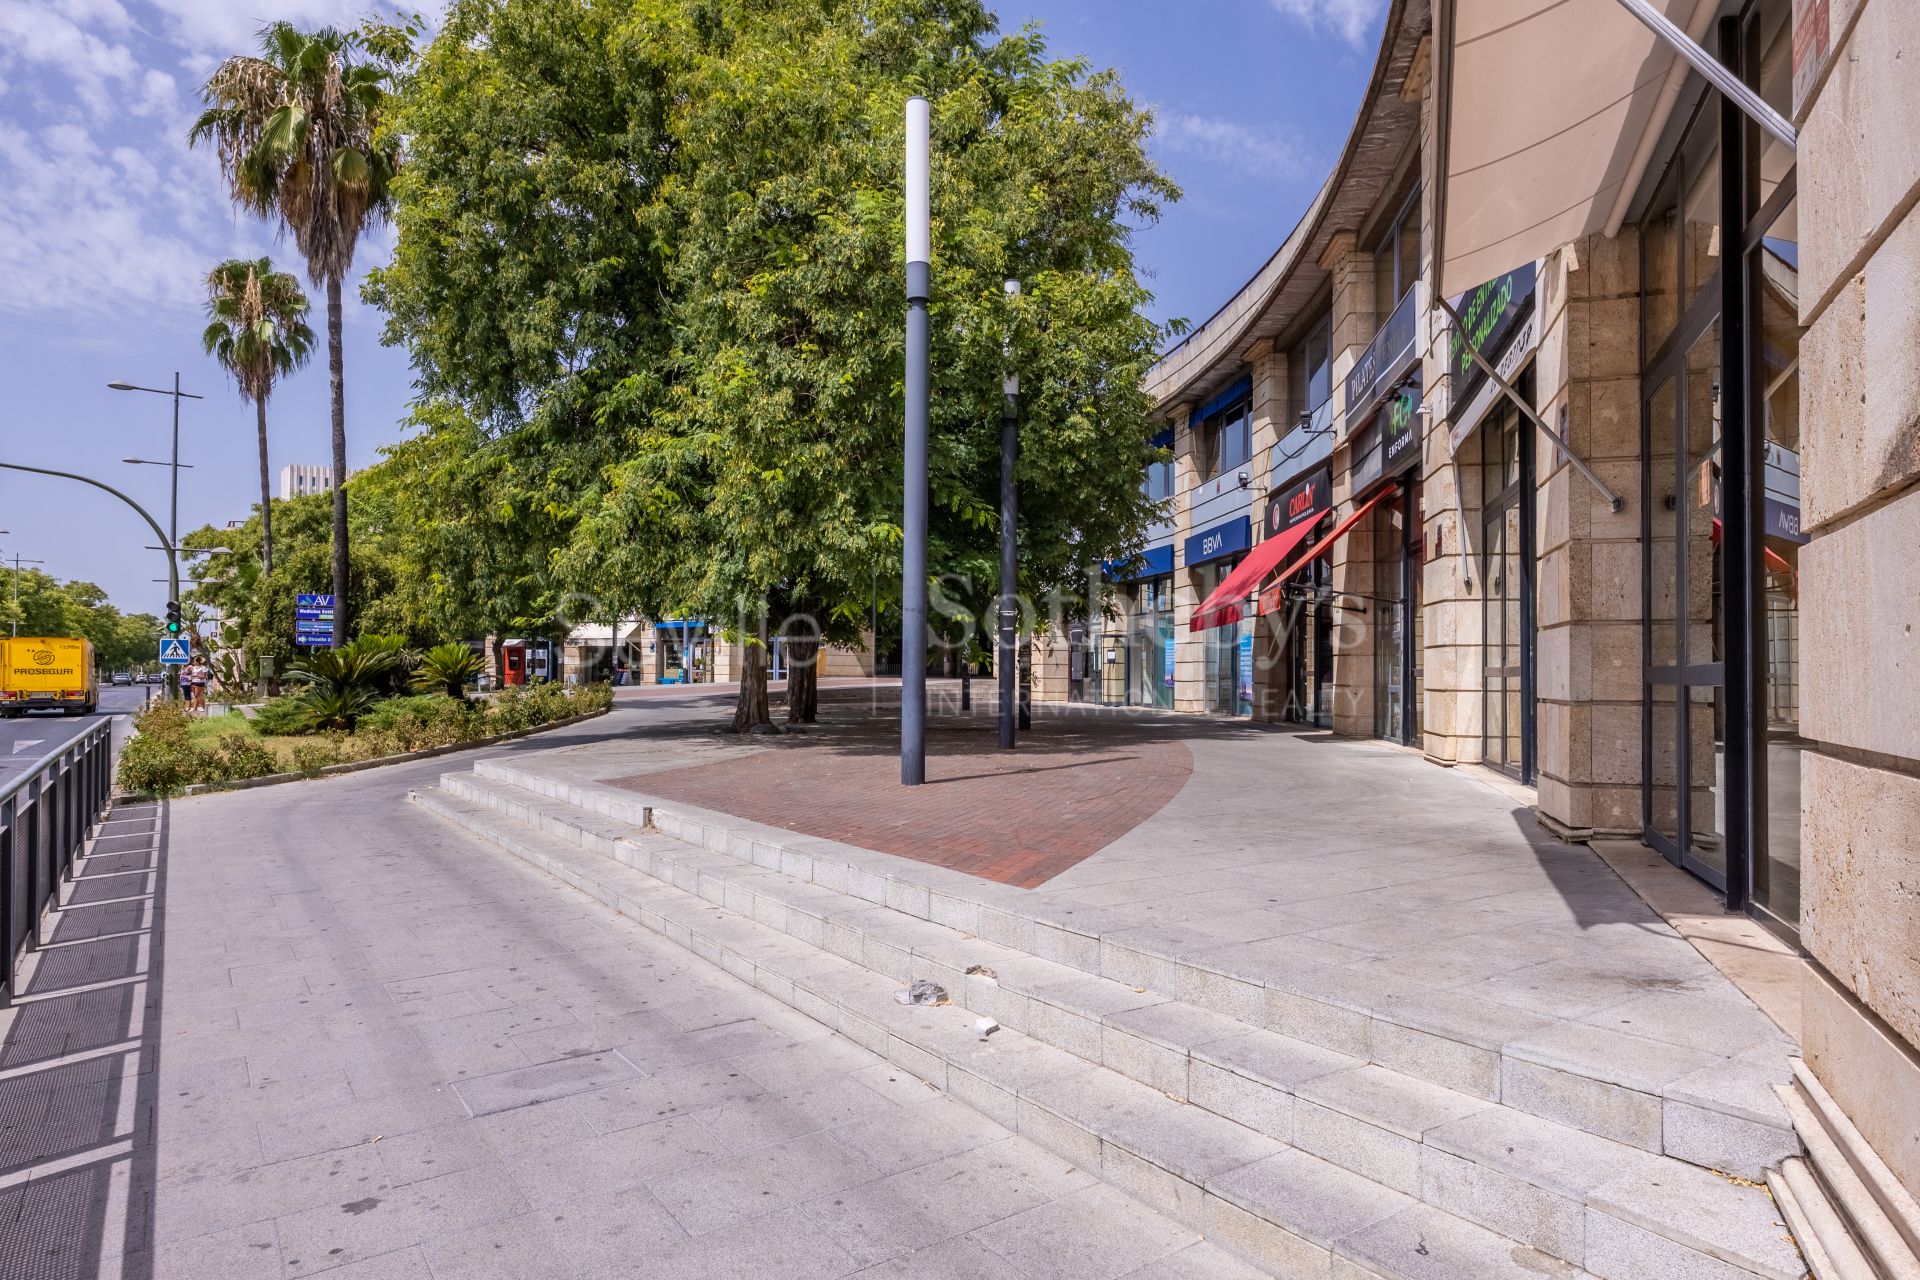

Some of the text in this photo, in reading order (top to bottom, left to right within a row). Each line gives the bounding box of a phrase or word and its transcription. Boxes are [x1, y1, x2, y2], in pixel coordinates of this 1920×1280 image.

[1388, 428, 1413, 459] ENFORMA
[1202, 531, 1223, 556] BBVA
[313, 595, 330, 606] AV
